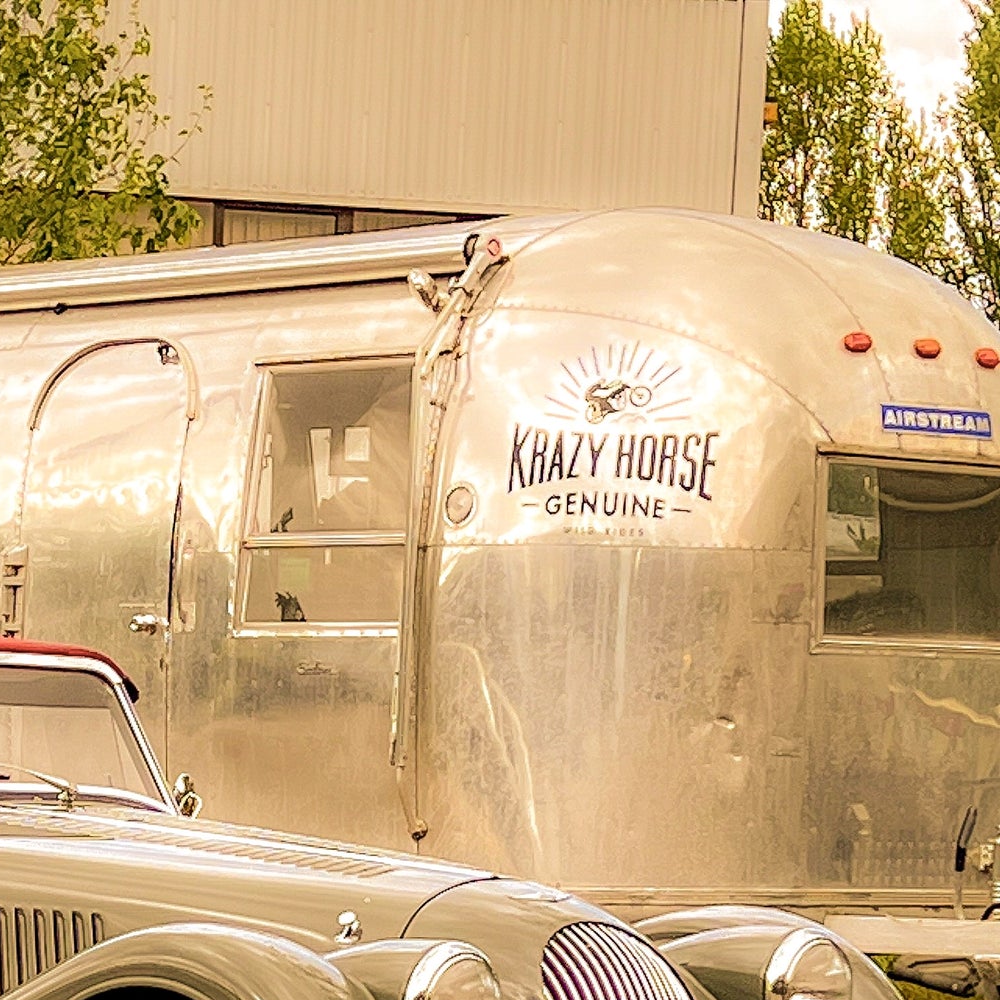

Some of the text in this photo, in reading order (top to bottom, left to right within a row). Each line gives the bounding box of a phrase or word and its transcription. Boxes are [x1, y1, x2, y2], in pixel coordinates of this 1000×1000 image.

[886, 410, 988, 431] AIRSTREAM
[508, 423, 719, 500] KRAZY HORSE
[545, 491, 666, 519] GENUINE
